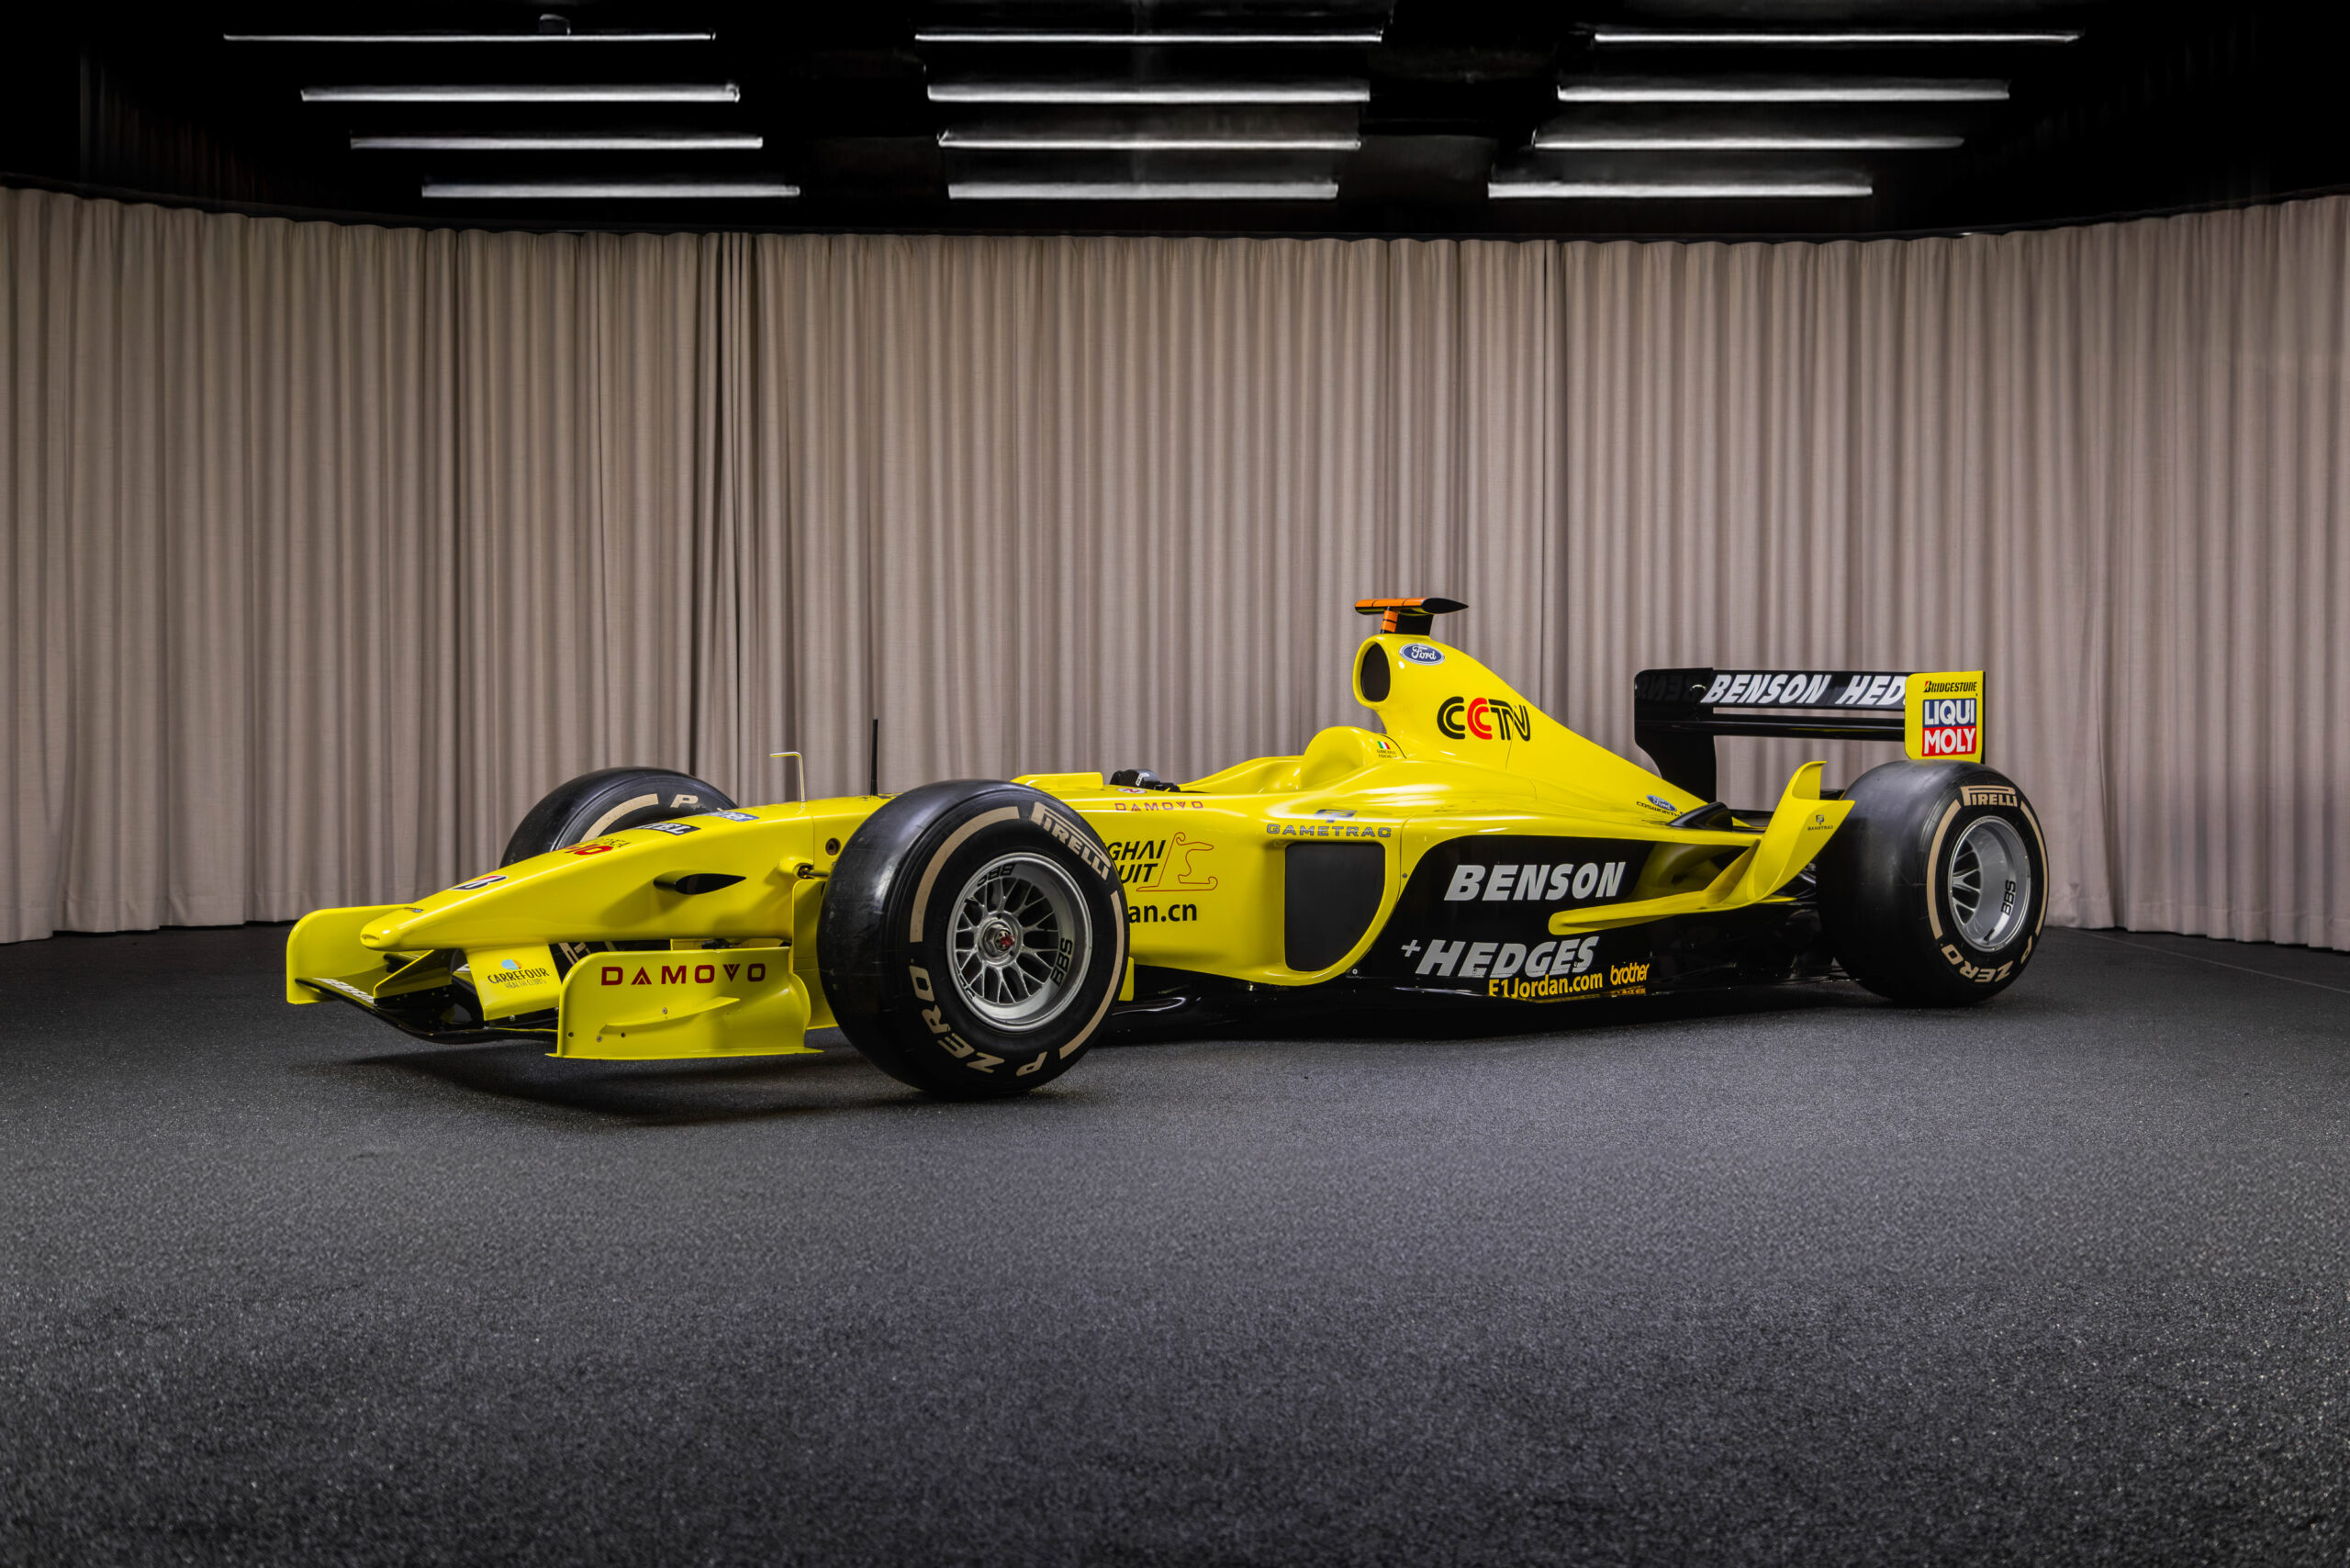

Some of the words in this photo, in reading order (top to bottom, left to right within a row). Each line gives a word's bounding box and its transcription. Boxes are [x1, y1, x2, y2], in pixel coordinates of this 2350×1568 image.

[1411, 644, 1437, 661] Ford
[1700, 674, 1832, 704] BENSON
[1835, 675, 1907, 706] HED
[1923, 680, 1977, 693] BRIDGESTONE
[1437, 696, 1531, 742] CCTV
[1924, 700, 1975, 726] LIQUI
[1924, 728, 1976, 755] MOLY
[1114, 801, 1203, 812] DAMOVO
[1961, 785, 2019, 808] PIRELLI
[1030, 801, 1112, 881] PIRELLI
[1266, 823, 1392, 838] GAMETRAC
[1104, 839, 1167, 861] GHAI
[1118, 862, 1158, 884] UIT
[1443, 861, 1627, 902] BENSON
[2001, 879, 2017, 916] BBS
[1128, 903, 1197, 924] an.cn
[601, 963, 767, 986] DAMOVO
[1610, 962, 1651, 986] brother
[1941, 943, 2014, 983] ZERO
[487, 968, 548, 984] CARREFOUR
[908, 965, 1006, 1074] ZERO
[1015, 1050, 1048, 1077] P
